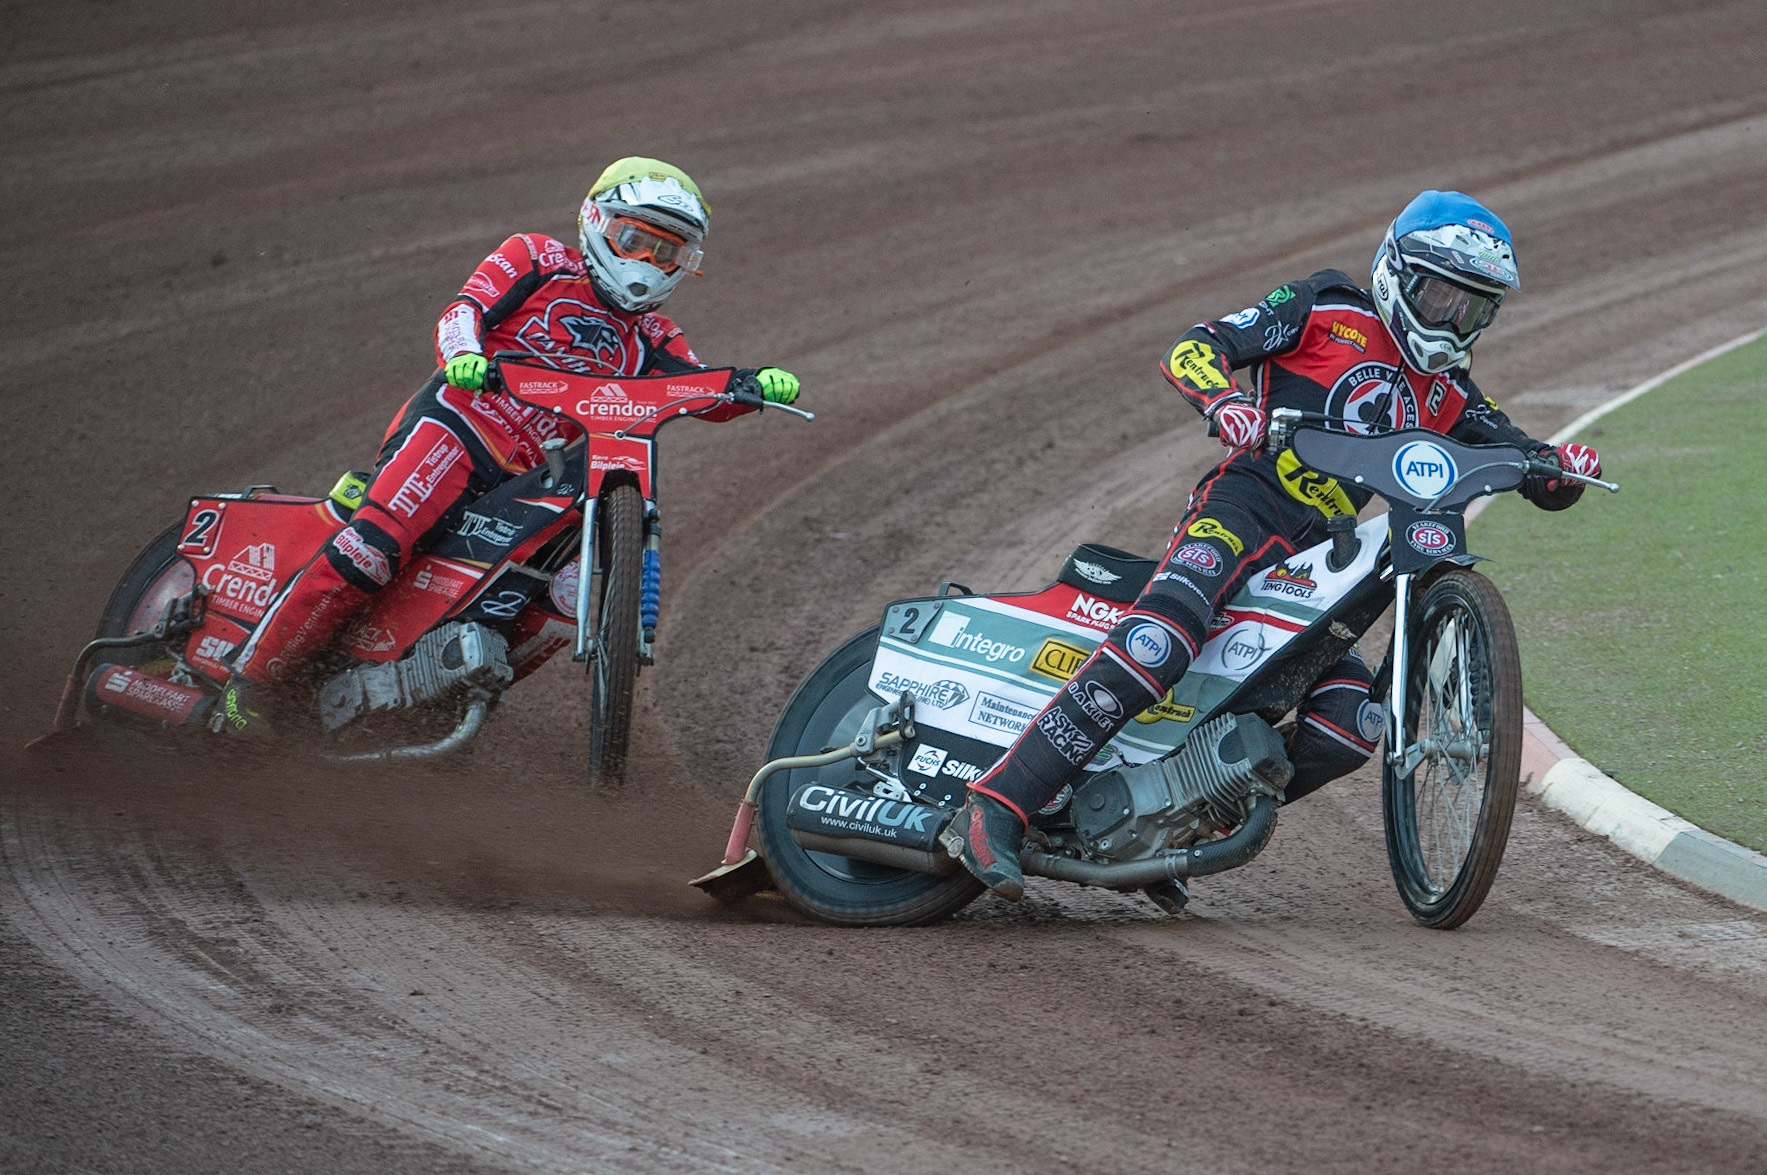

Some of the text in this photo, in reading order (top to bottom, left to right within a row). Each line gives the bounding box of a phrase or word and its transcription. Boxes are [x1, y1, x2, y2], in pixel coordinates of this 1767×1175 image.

[519, 381, 558, 389] FASTRACK
[666, 384, 704, 393] FASTRACK
[1348, 368, 1380, 387] BELLE
[1403, 396, 1415, 428] ACES
[575, 400, 657, 418] Crendon
[1406, 460, 1443, 478] ATPI
[184, 509, 220, 546] 2
[1418, 530, 1441, 545] STS
[1182, 548, 1210, 564] STS
[211, 595, 238, 610] TIMBER
[1070, 593, 1123, 624] NGK
[900, 607, 919, 634] 2
[1066, 611, 1091, 625] SPARK
[951, 626, 1026, 663] integro
[1134, 633, 1162, 657] ATPI
[1227, 641, 1258, 660] ATPI
[880, 672, 949, 701] SAPPHIRE
[1364, 711, 1384, 726] ATP
[1038, 714, 1085, 765] RACING
[914, 755, 941, 767] FUCHS
[941, 760, 983, 781] Silk
[820, 815, 898, 838] www.civiluk.uk
